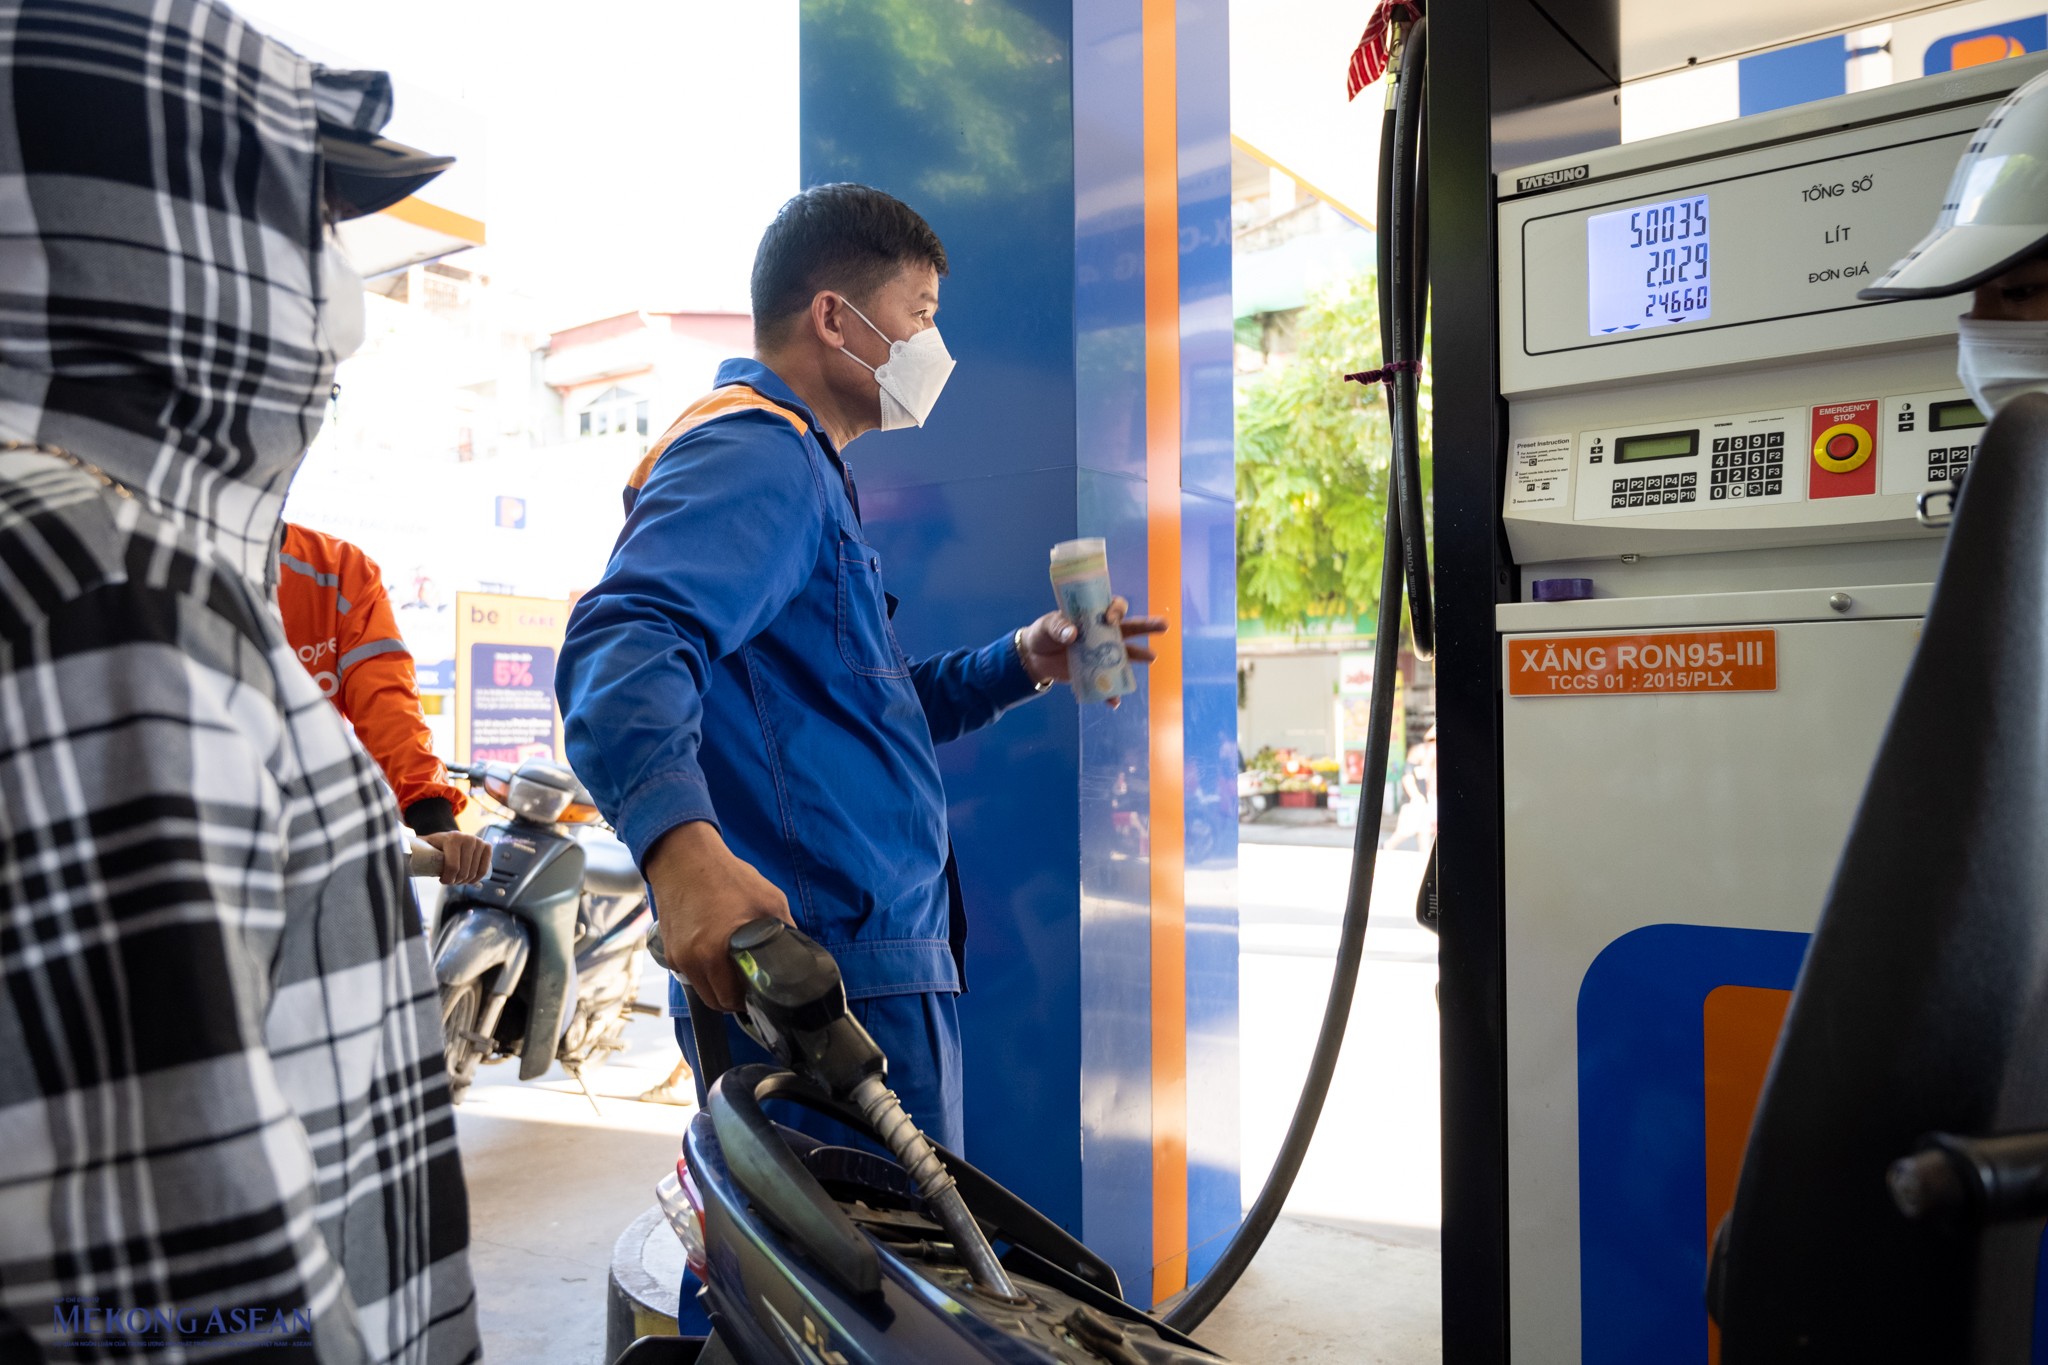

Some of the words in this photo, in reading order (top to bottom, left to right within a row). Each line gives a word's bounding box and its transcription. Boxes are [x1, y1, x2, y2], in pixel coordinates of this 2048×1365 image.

[1519, 166, 1586, 190] TATSUNO
[1801, 183, 1845, 202] TỔNG
[1851, 173, 1874, 193] SỐ
[1630, 199, 1707, 249] 50035
[1825, 224, 1851, 244] LÍT
[1808, 268, 1840, 283] ĐƠN
[1843, 261, 1870, 278] GIÁ
[1645, 285, 1708, 317] 24660
[1819, 403, 1872, 416] EMERGENCY
[1833, 413, 1856, 422] STOP
[1537, 439, 1570, 447] Instruction
[1717, 440, 1726, 451] 7
[1734, 438, 1743, 449] 8
[1752, 436, 1762, 447] 9
[1770, 436, 1781, 444] F1
[1715, 456, 1724, 467] 4
[1734, 454, 1742, 465] 5
[1752, 452, 1761, 463] 6
[1769, 452, 1781, 460] F2
[1930, 452, 1945, 461] P1
[1951, 450, 1967, 459] P2
[1715, 471, 1722, 482] 1
[1732, 470, 1742, 481] 2
[1751, 468, 1760, 479] 3
[1768, 468, 1780, 476] F3
[1930, 469, 1946, 479] P6
[1951, 467, 1966, 477] P7
[1614, 482, 1626, 490] P1
[1631, 480, 1643, 489] P2
[1648, 478, 1660, 487] P3
[1665, 477, 1678, 485] P4
[1682, 475, 1696, 484] P5
[1613, 497, 1625, 506] P6
[1630, 496, 1642, 504] P7
[1647, 494, 1659, 503] P8
[1664, 493, 1677, 501] P9
[1680, 491, 1696, 500] P10
[1714, 487, 1723, 499] 0
[1731, 485, 1743, 497] C
[1767, 484, 1780, 492] F4
[471, 605, 499, 624] be
[1520, 643, 1607, 672] XĂNG
[1617, 641, 1763, 670] RON95-III
[493, 660, 534, 688] 5%
[1548, 674, 1599, 690] TCCS
[1604, 674, 1625, 689] 01
[1643, 670, 1734, 689] 2015/PLX
